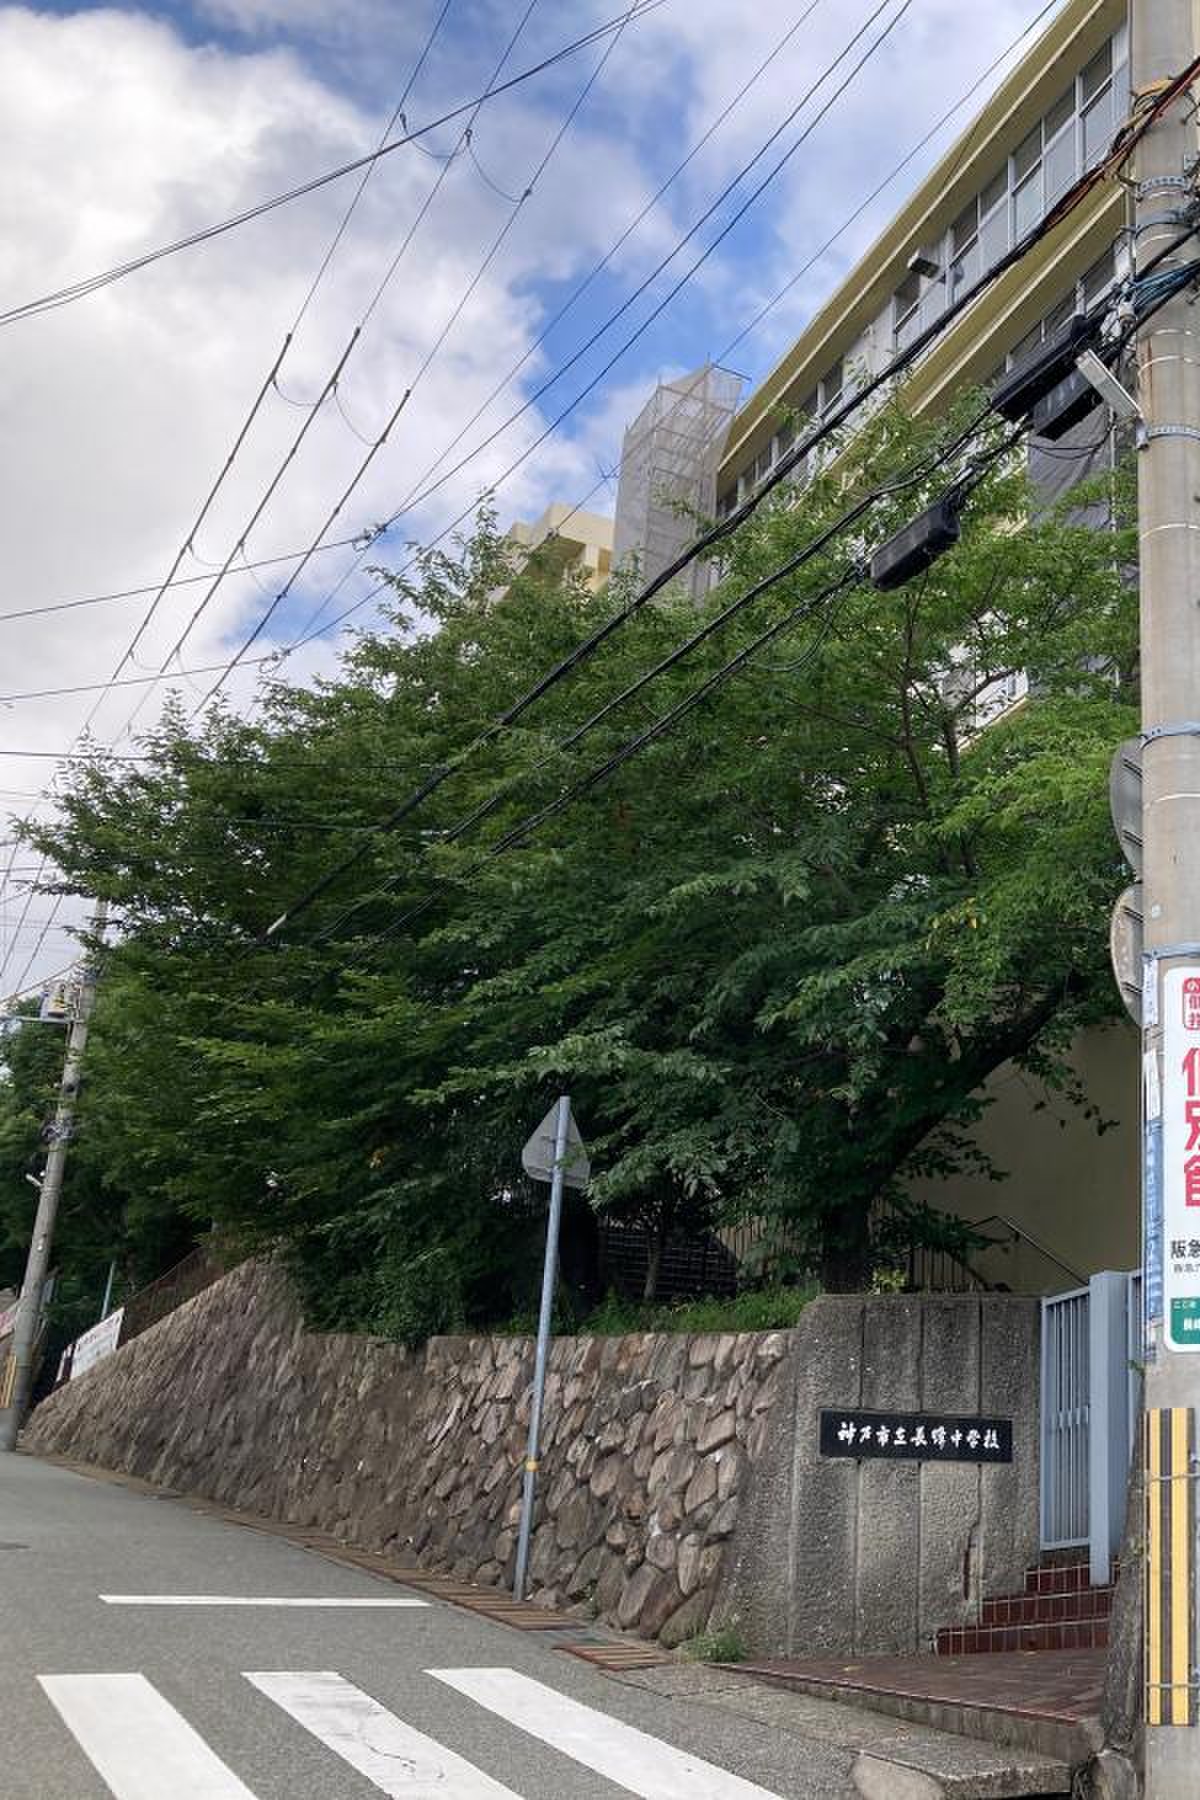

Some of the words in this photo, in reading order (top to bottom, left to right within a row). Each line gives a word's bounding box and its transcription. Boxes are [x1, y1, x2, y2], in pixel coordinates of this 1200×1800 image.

[837, 1421, 999, 1449] 神戸市立長峰中学校
